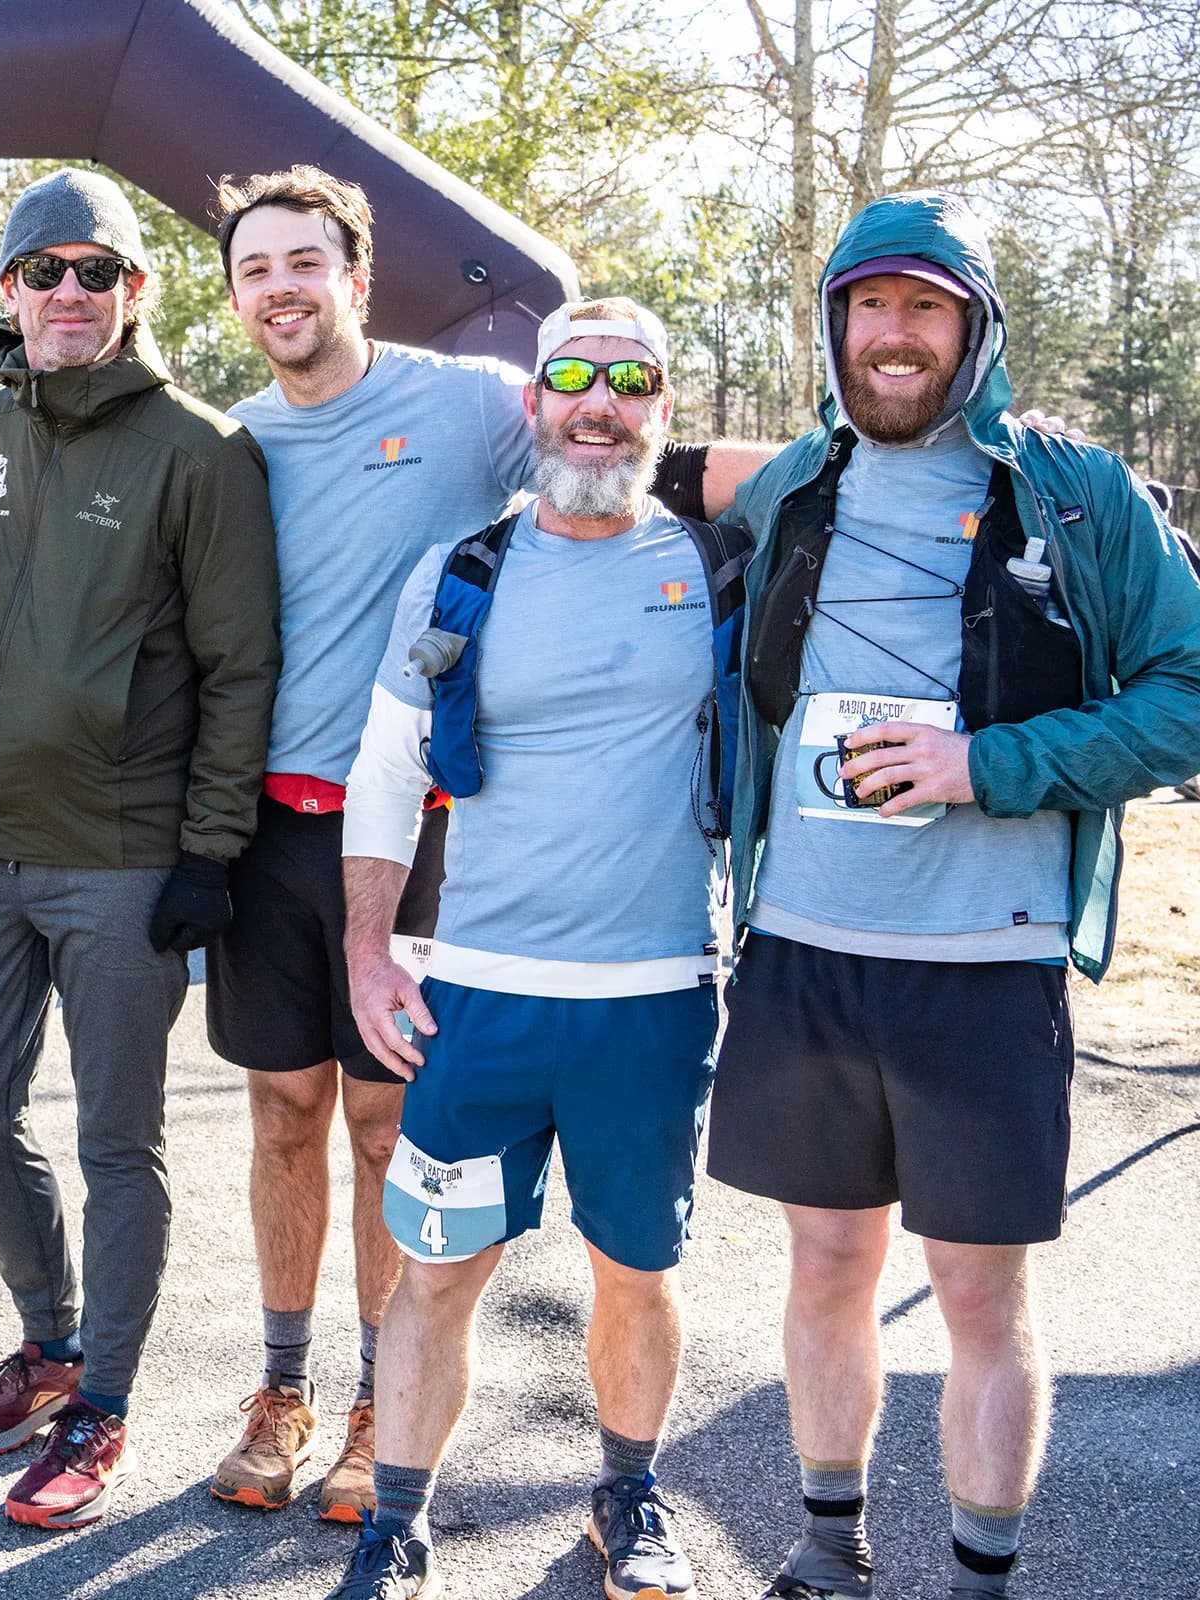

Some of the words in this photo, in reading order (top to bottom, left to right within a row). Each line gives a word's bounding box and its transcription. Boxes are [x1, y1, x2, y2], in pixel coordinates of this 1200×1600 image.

[369, 457, 422, 471] RUNNING
[651, 602, 706, 613] RUNNING
[412, 942, 432, 957] RABI
[428, 1163, 463, 1182] RACCOON
[419, 1206, 449, 1255] 4
